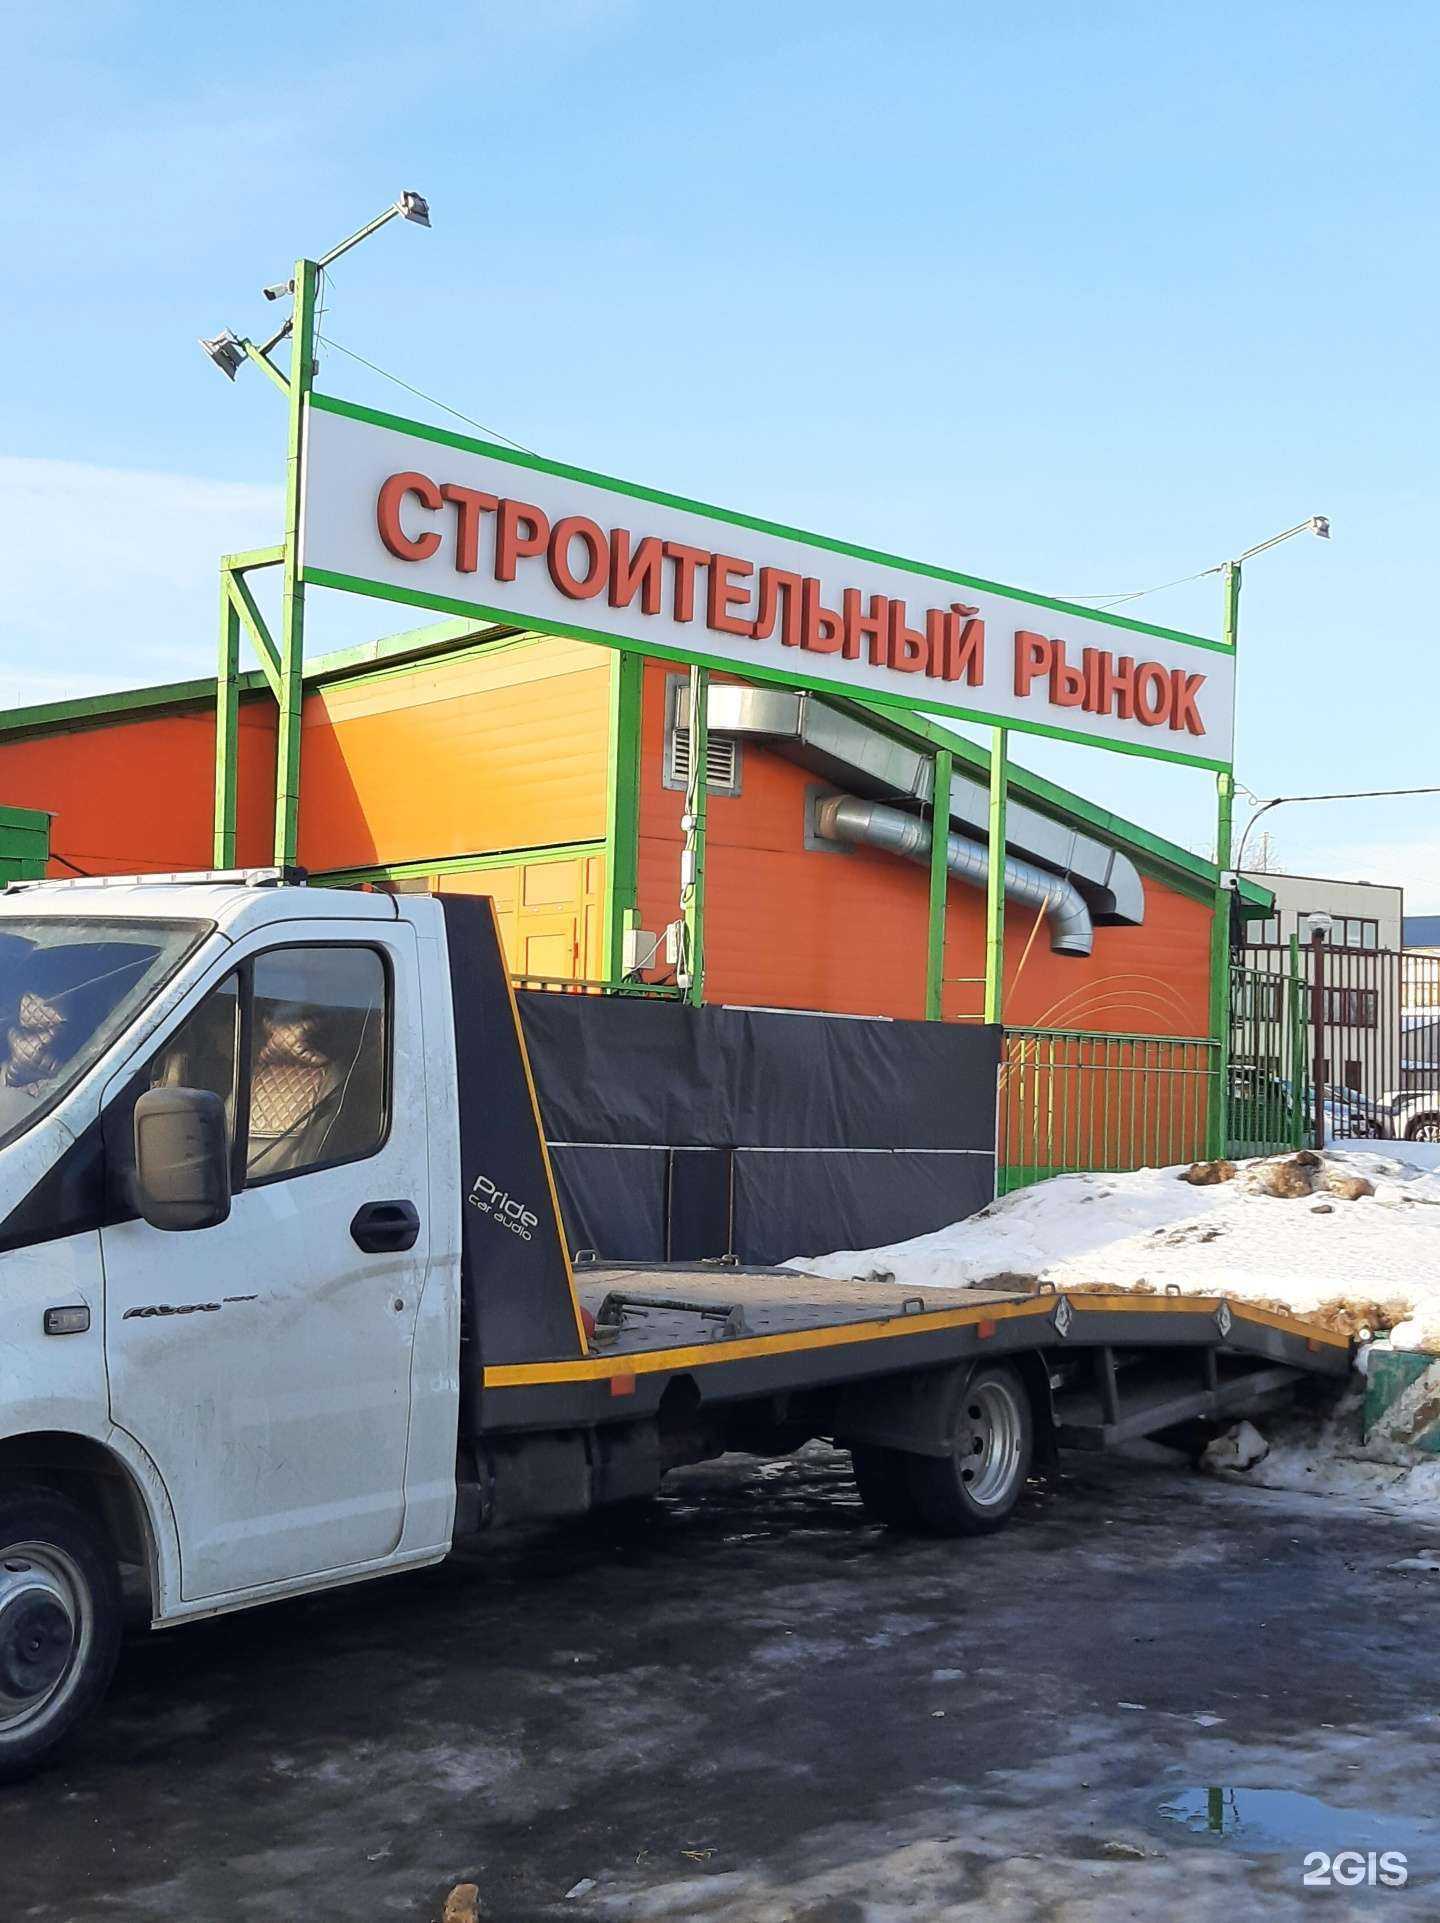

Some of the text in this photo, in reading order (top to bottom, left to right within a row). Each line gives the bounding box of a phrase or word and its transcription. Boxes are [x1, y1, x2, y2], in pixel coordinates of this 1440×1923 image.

[376, 471, 1208, 737] СТРОИТЕЛЬНЫЙ РЫНОК
[468, 1194, 532, 1241] car audio
[473, 1176, 538, 1227] Pride
